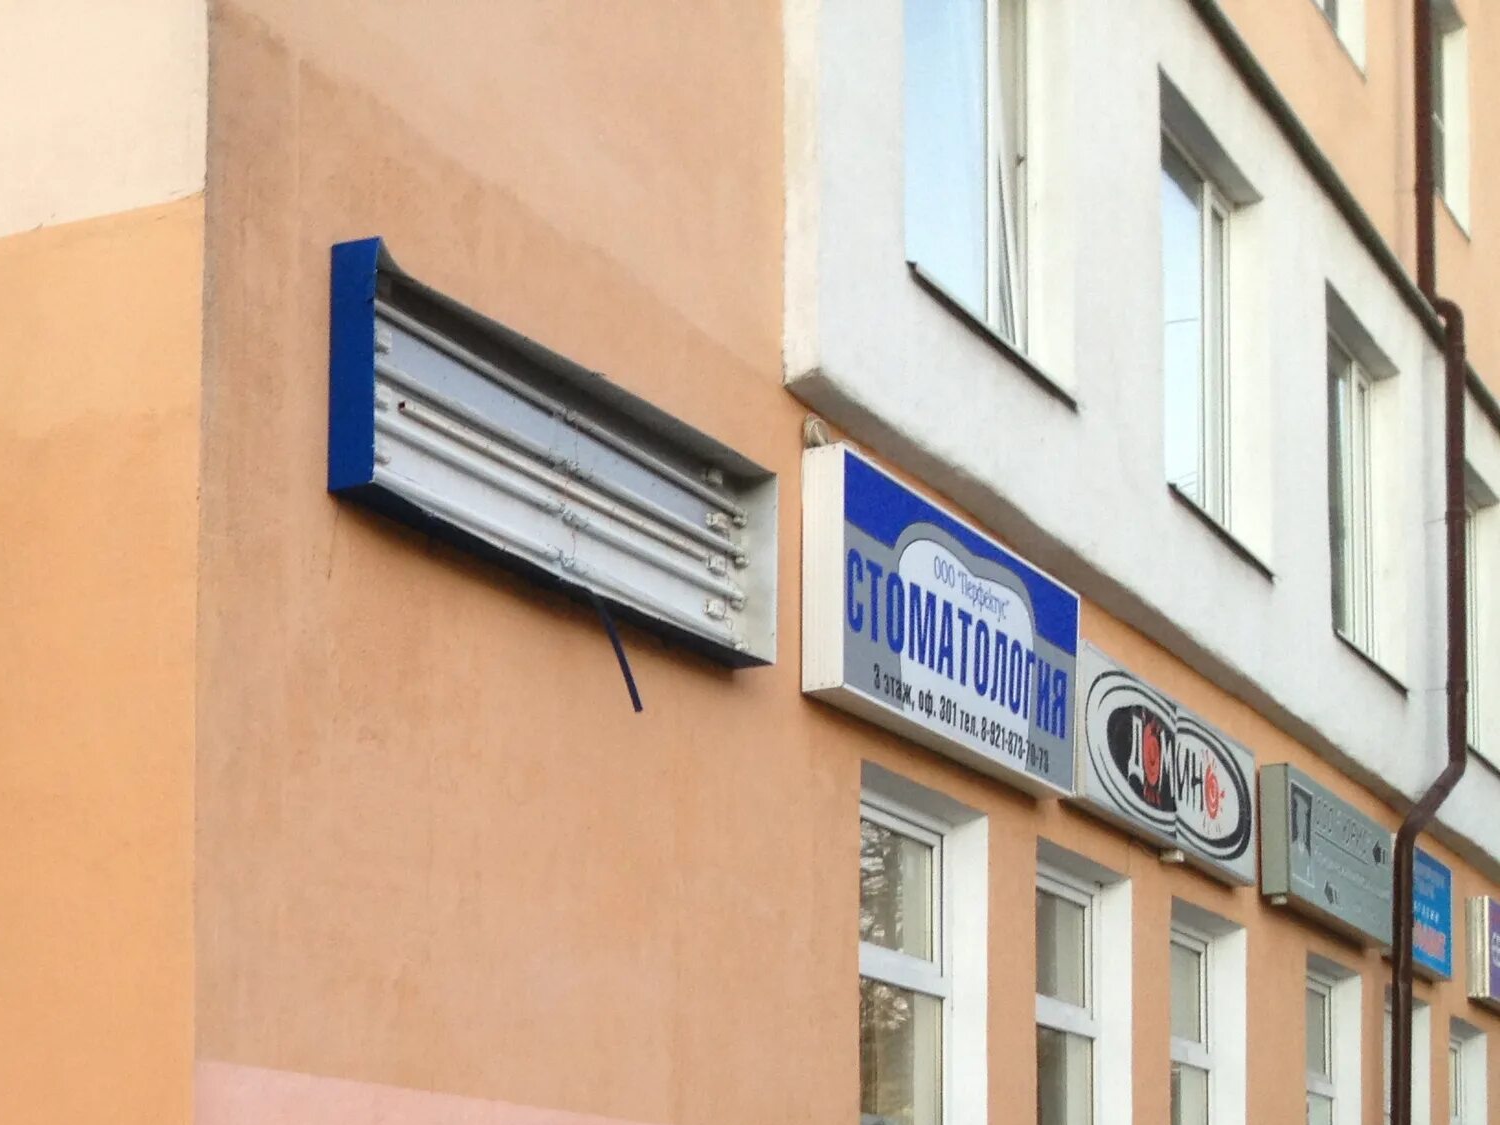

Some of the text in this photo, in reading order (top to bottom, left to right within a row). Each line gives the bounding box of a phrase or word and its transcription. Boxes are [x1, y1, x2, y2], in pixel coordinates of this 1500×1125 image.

[847, 548, 1068, 740] СТОМАТОЛОГИЯ
[873, 662, 880, 690] 3
[883, 672, 915, 712] этаж,
[919, 689, 937, 718] оф.
[940, 695, 957, 727] 301
[960, 709, 979, 738] тел.
[1128, 713, 1221, 822] ДОМИНО
